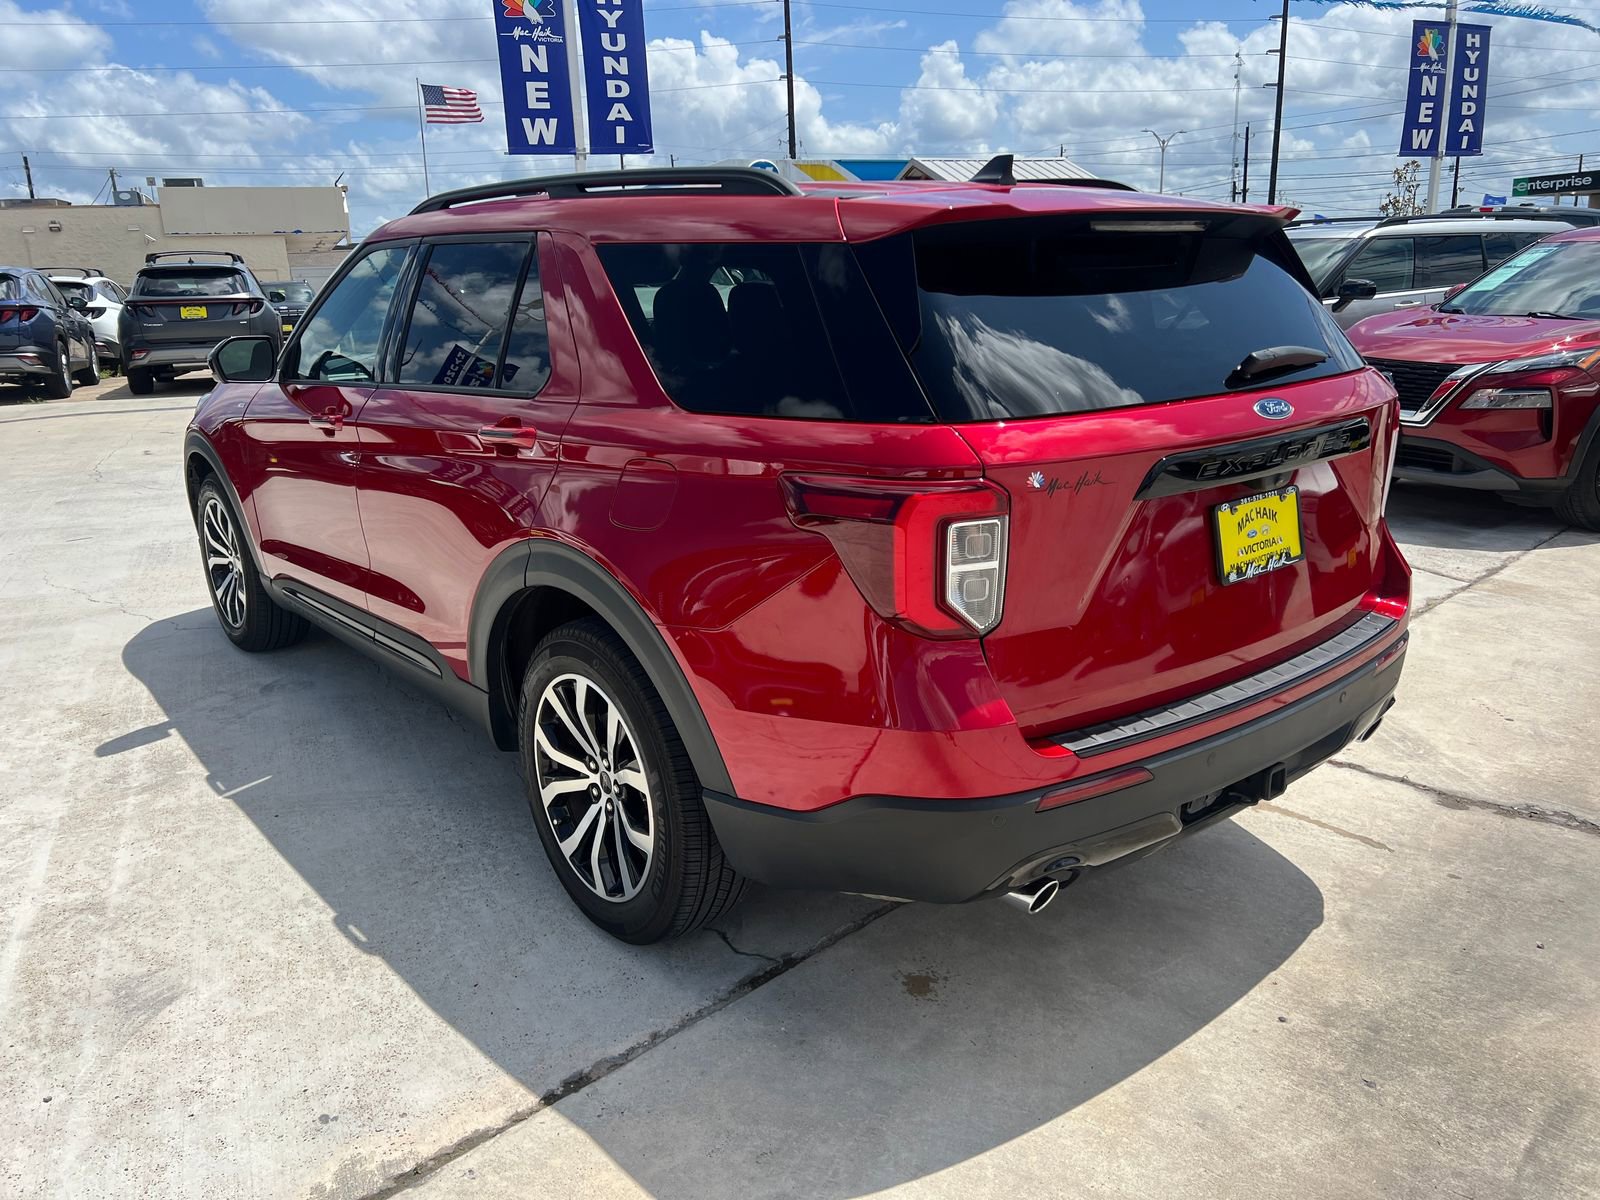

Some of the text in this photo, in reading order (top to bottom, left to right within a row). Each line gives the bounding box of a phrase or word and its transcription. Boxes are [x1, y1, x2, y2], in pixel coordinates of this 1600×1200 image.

[505, 26, 562, 41] Mac Haik
[596, 0, 633, 144] YUNDAI
[520, 45, 558, 145] NEW
[1458, 33, 1480, 149] HYUNDAI
[1412, 76, 1437, 150] NEW
[1513, 175, 1593, 192] enterprise
[1196, 432, 1351, 480] EXPLORER
[1044, 470, 1113, 498] Mac Haik
[1237, 507, 1255, 535] MAC
[1255, 507, 1278, 523] HAIK
[1230, 546, 1292, 571] MACHIKVICTOIACOM
[1244, 537, 1277, 555] VICTORIA
[1242, 552, 1297, 579] Mac Haik
